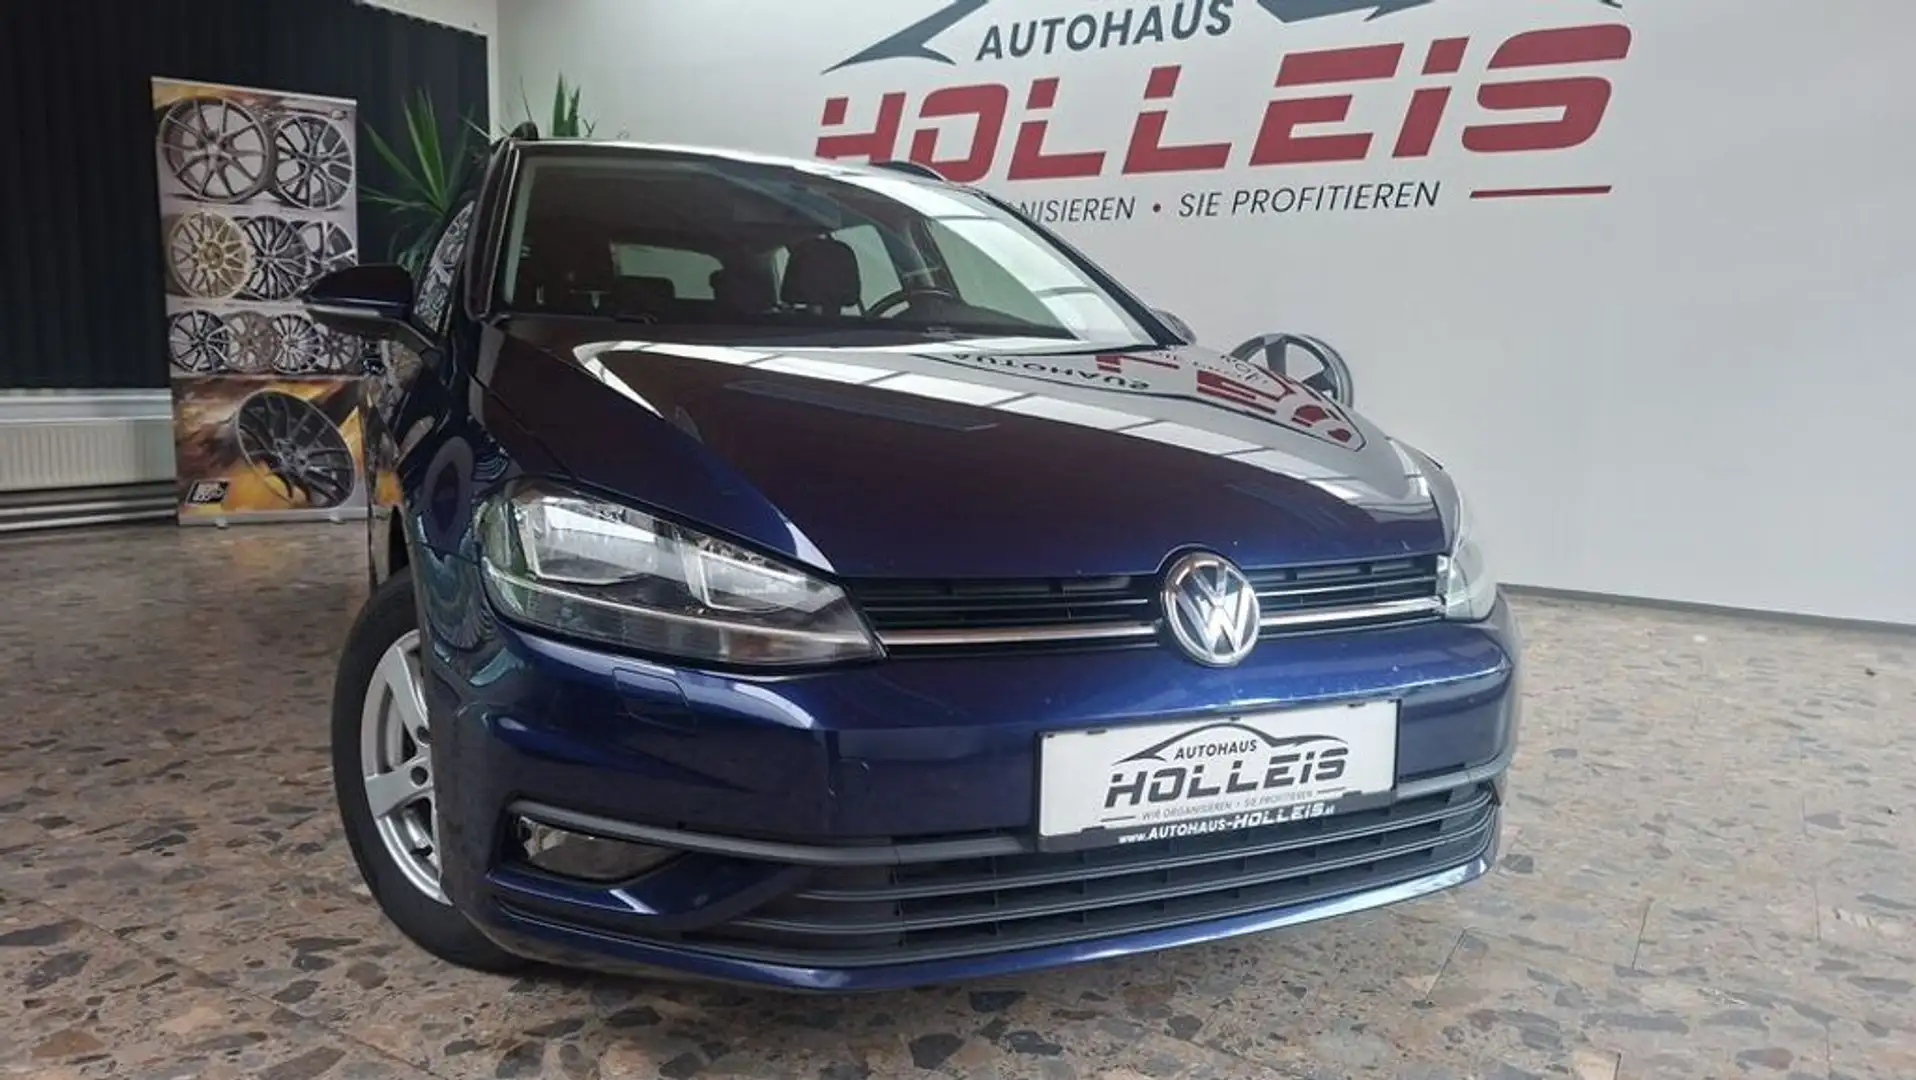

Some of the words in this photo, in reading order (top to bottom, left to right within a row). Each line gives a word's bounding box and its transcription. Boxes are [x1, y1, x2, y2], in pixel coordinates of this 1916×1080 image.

[975, 0, 1234, 61] AUTOHAUS
[1008, 196, 1136, 223] NISIEREN
[1178, 192, 1223, 218] SIE
[1231, 181, 1441, 216] PROFITIEREN
[1174, 740, 1258, 760] AUTOHAUS
